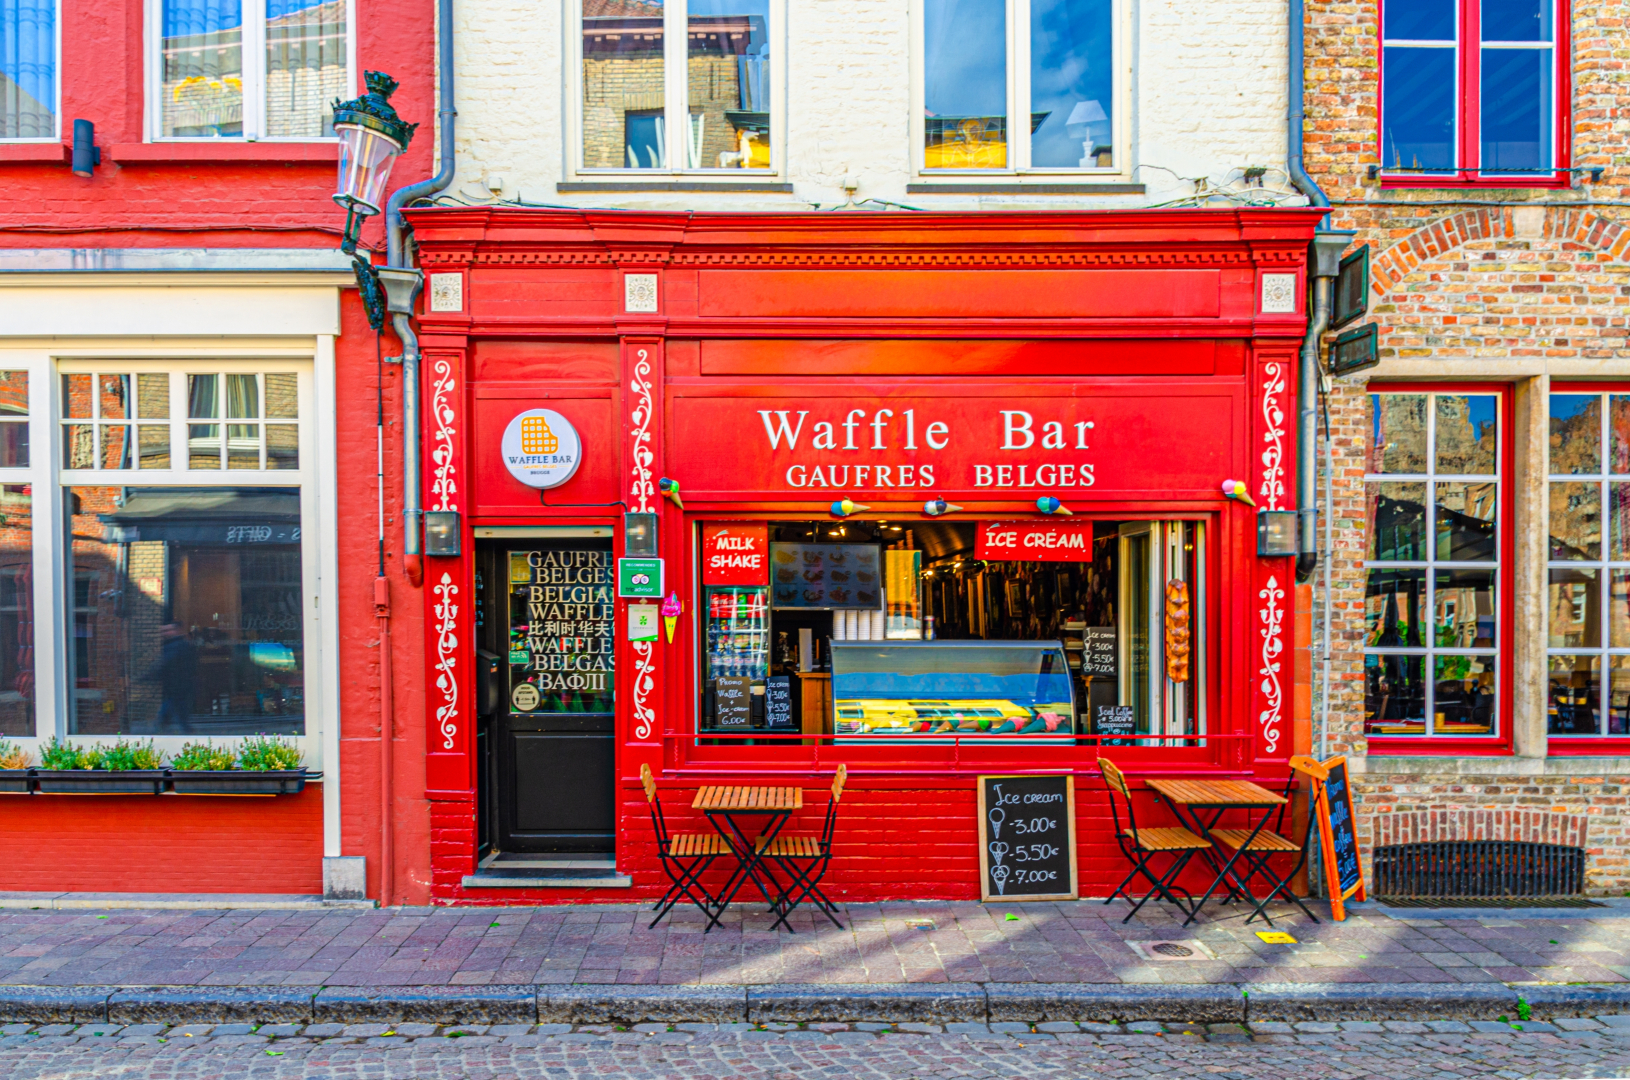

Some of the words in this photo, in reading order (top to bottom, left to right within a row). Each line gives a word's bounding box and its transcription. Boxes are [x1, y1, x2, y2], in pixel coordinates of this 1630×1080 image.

[757, 409, 949, 450] Waffle
[999, 410, 1094, 450] Bar
[508, 455, 549, 464] WAFFLE
[552, 455, 573, 464] BAR
[786, 465, 935, 487] GAUFRES
[973, 464, 1096, 487] BELGES
[716, 537, 755, 550] MILK
[985, 531, 1017, 547] ICE
[1023, 532, 1084, 548] CREAM
[710, 554, 761, 568] SHAKE
[536, 568, 614, 584] BELGES
[529, 586, 614, 603] BELGIA
[528, 621, 615, 636] 比利时华夫
[534, 654, 615, 671] BELGAS
[717, 689, 744, 698] Waffle
[721, 715, 746, 724] 6.00€
[993, 784, 1021, 806] Ice
[1023, 793, 1063, 804] cream
